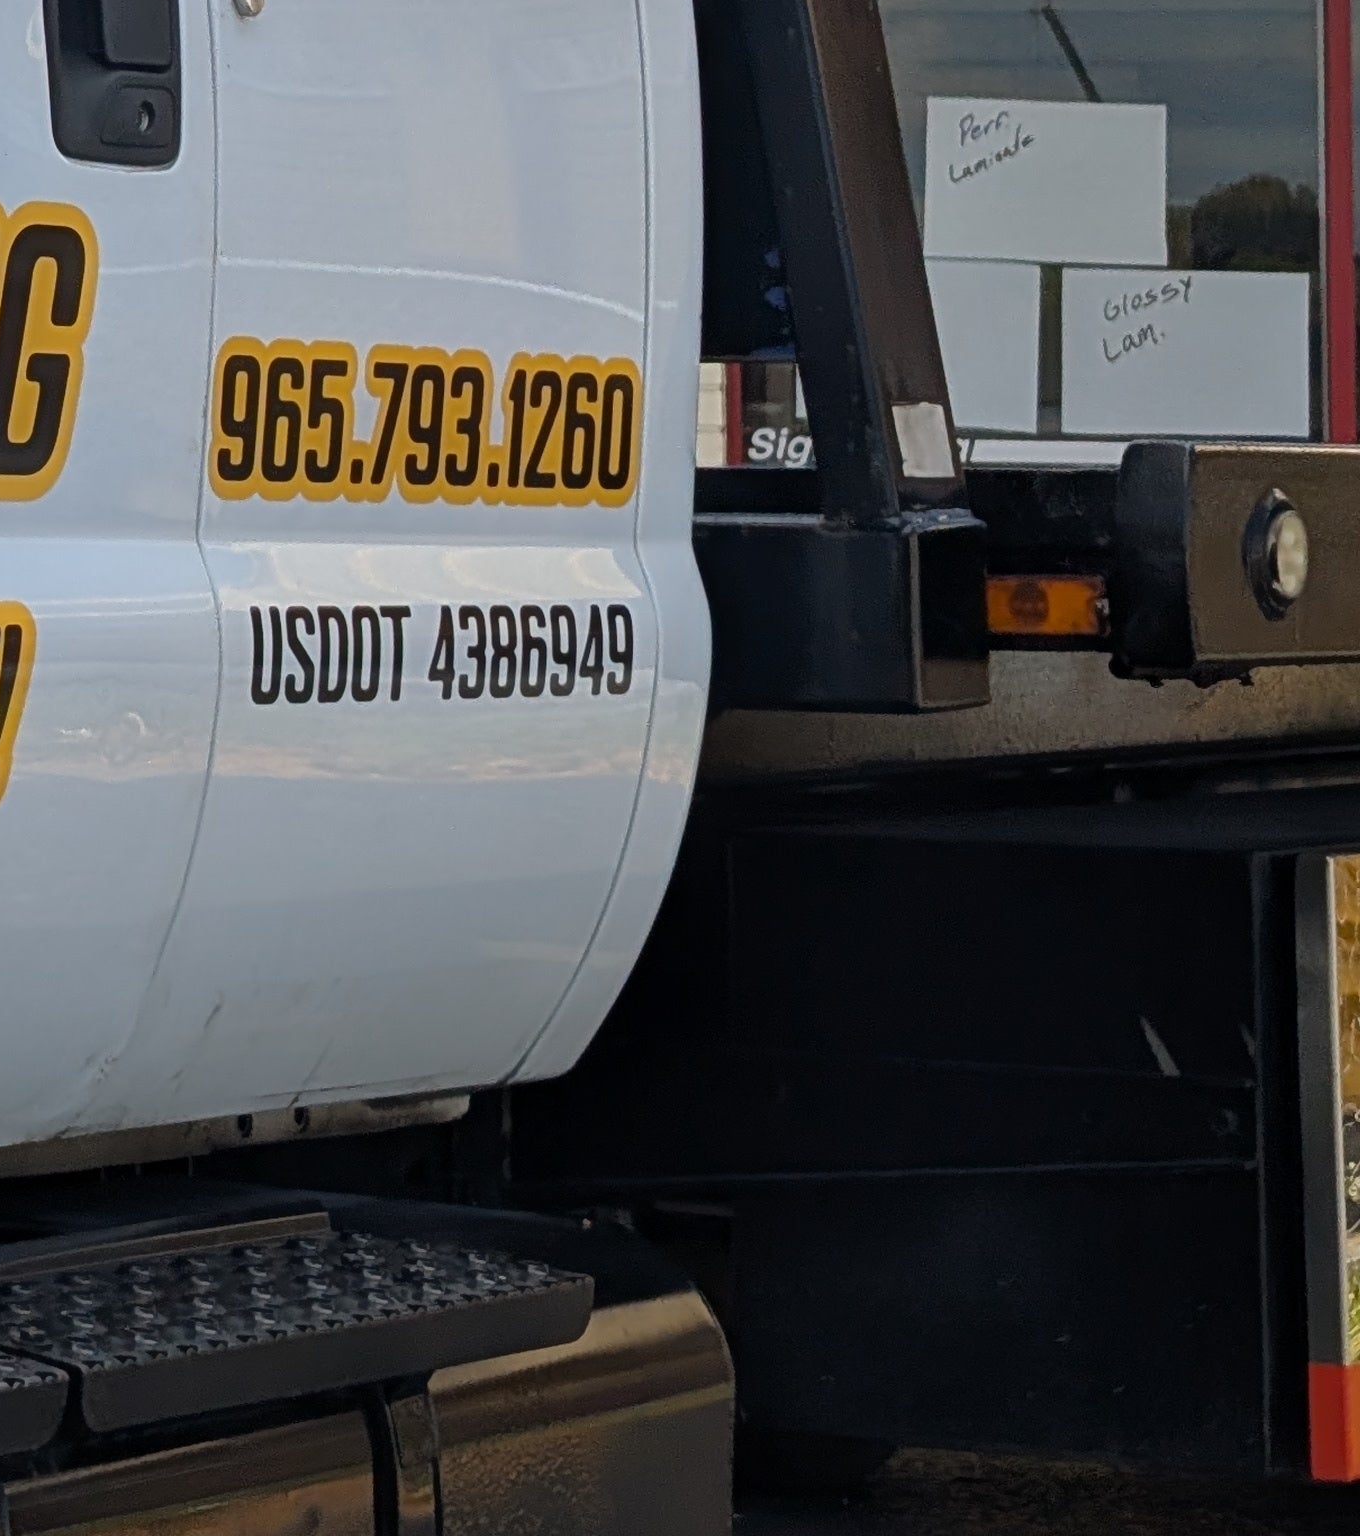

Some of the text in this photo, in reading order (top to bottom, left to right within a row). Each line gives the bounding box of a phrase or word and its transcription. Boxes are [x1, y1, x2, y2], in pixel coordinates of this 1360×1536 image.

[216, 353, 635, 491] 965.793.1260
[747, 426, 816, 467] Sig
[250, 604, 634, 705] USDOT 4386949
